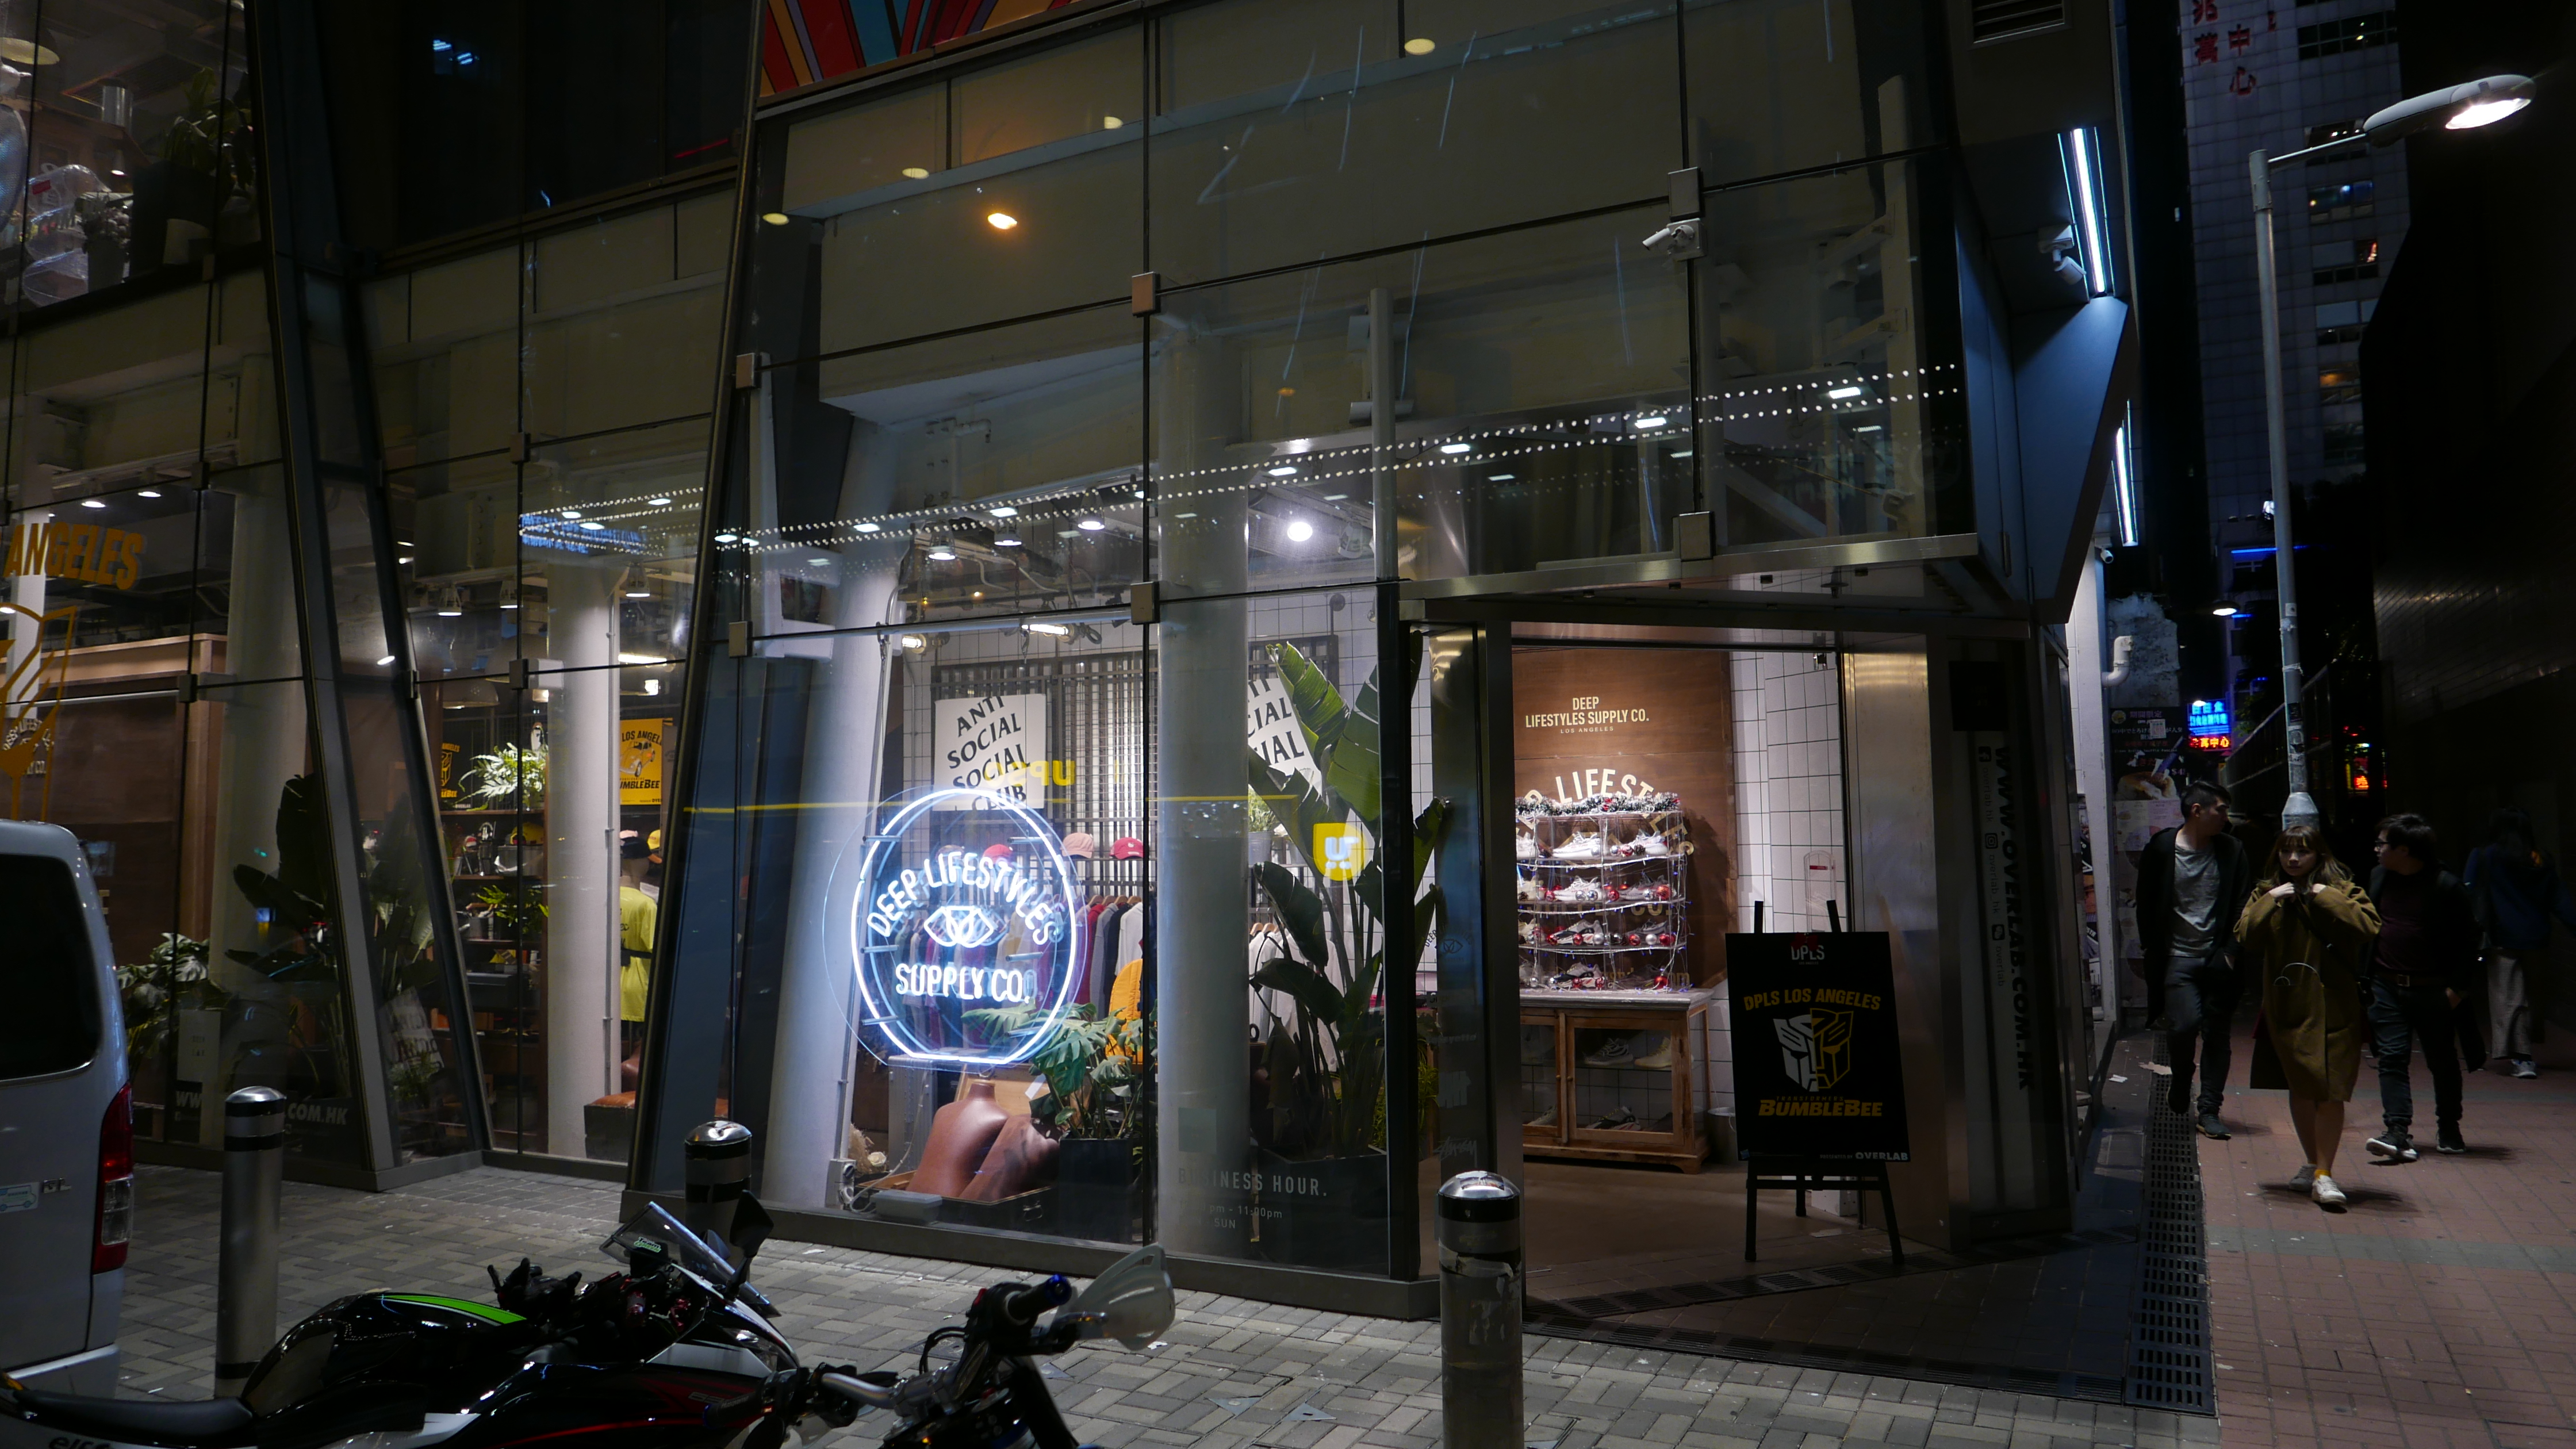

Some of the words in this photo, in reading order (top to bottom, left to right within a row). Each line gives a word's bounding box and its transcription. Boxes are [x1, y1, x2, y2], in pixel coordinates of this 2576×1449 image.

[2228, 24, 2256, 95] 中心
[3, 522, 143, 591] ANGELES
[957, 696, 1005, 737] ANTI
[1525, 712, 1585, 728] LIFESTYLES
[1588, 710, 1628, 724] SUPPLY
[1631, 708, 1650, 722] CO.
[1573, 696, 1599, 710] DEEP
[622, 730, 635, 742] LOS
[947, 713, 1021, 769] SOCIAL
[953, 744, 1031, 789] SOCIAL
[867, 869, 917, 937] DEEP
[924, 851, 1060, 945] LIFESTYLES
[1995, 746, 2035, 1090] WWW.OVERLAB.COM.HK
[1791, 945, 1826, 960] DPLS
[1996, 946, 2005, 987] overlab
[895, 963, 984, 1000] SUPPLY
[991, 969, 1030, 1004] CO.
[1743, 990, 1780, 1011] DPLS
[1784, 988, 1811, 1004] LOS
[1815, 988, 1882, 1010] ANGELES
[1855, 1151, 1908, 1160] OVERLAB
[1273, 1175, 1327, 1197] HOUR.
[1214, 1218, 1236, 1229] SUN
[1237, 1205, 1283, 1220] 11:00pm
